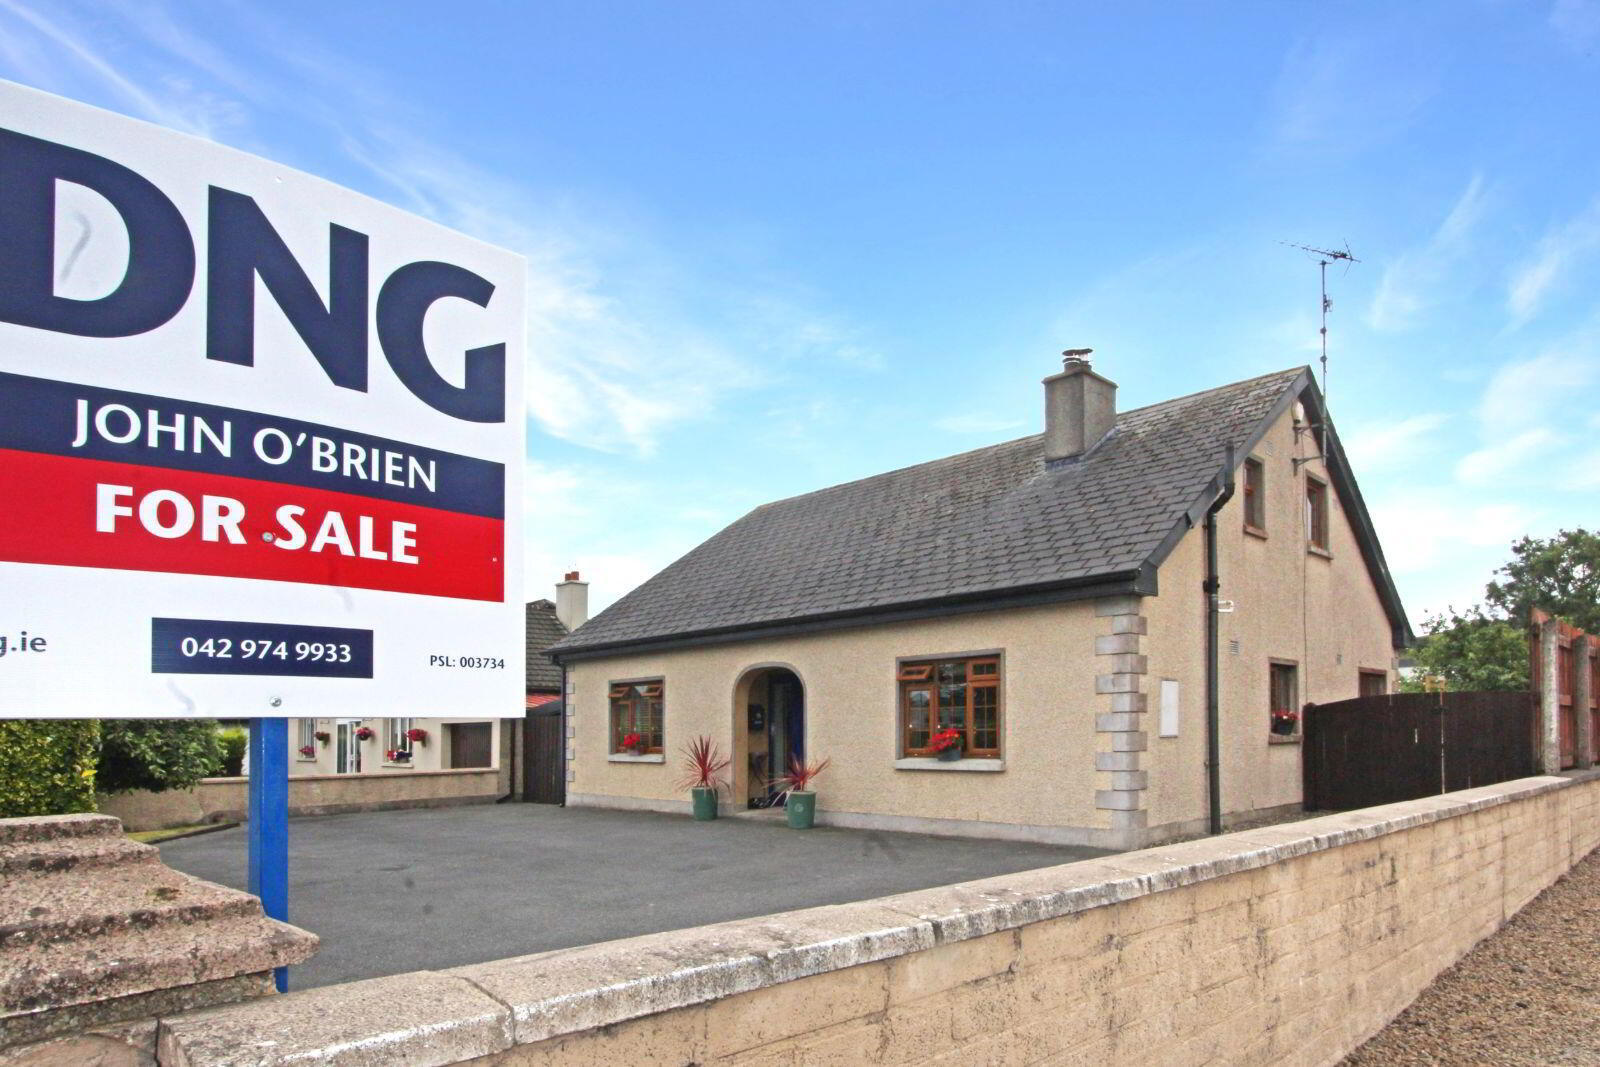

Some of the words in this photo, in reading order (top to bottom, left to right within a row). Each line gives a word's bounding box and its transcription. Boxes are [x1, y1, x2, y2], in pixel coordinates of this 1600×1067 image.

[0, 126, 506, 423] DNG
[71, 399, 232, 458] JOHN
[253, 427, 437, 493] O'BRIEN
[96, 482, 247, 545] FOR
[274, 504, 420, 565] SALE
[181, 637, 232, 658] 042
[240, 639, 288, 660] 974
[295, 642, 351, 663] 9933
[430, 654, 456, 667] PSL:
[459, 656, 505, 669] 003734
